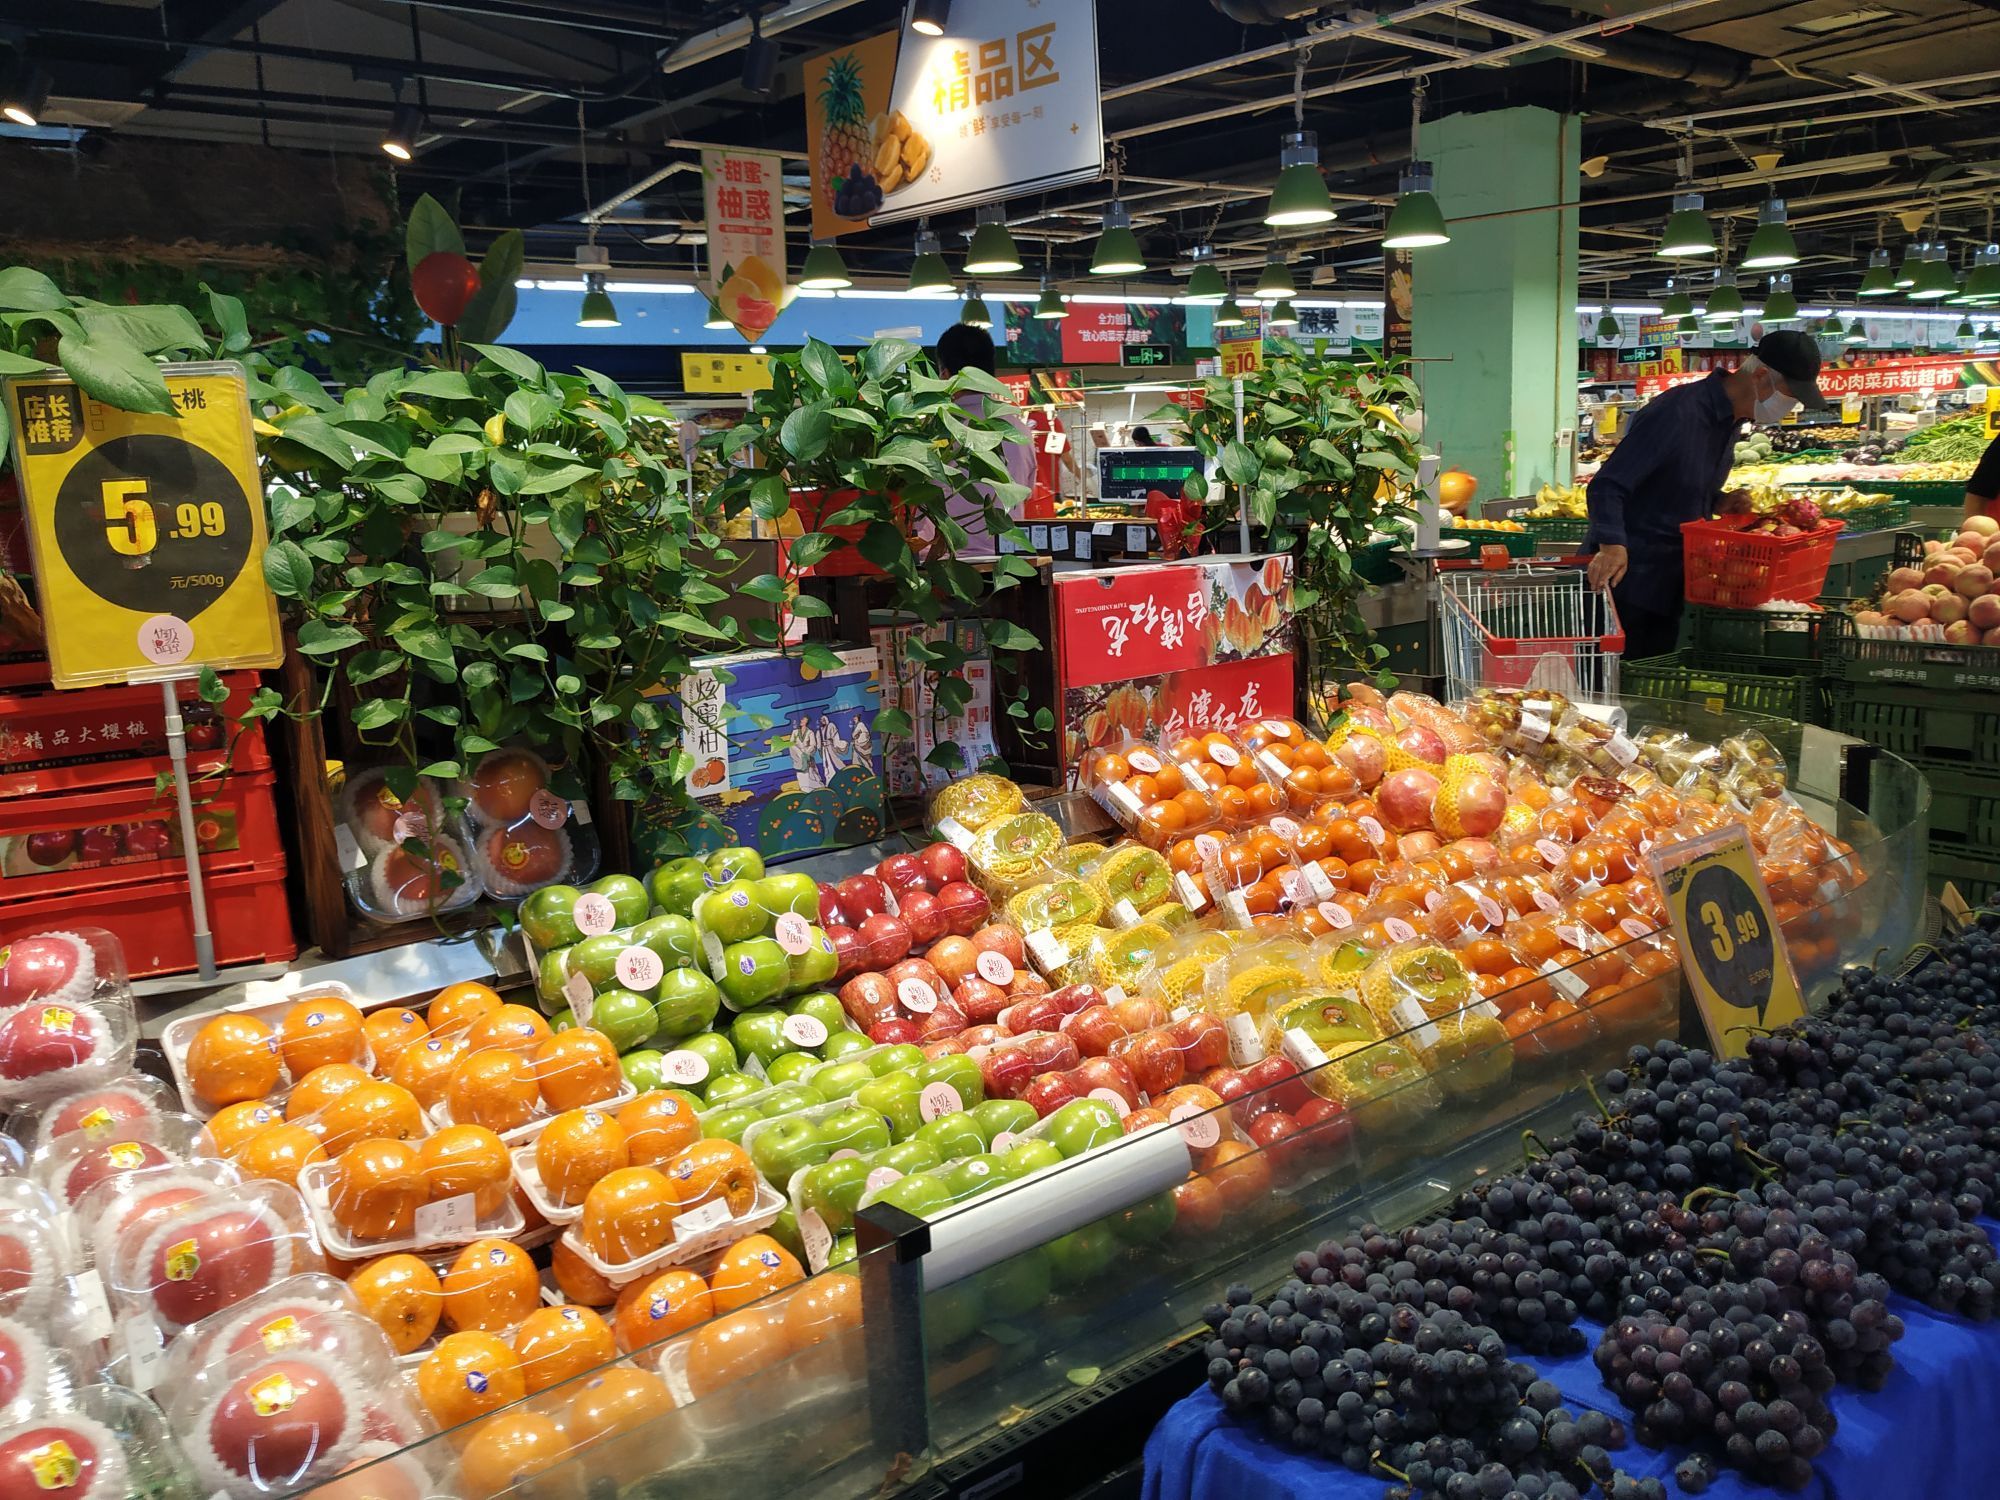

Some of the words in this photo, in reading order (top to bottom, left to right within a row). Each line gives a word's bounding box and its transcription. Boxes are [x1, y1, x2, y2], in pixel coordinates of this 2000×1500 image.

[932, 22, 1060, 115] 精品区
[717, 186, 772, 220] 柚惑
[24, 395, 70, 419] 店长
[27, 419, 73, 443] 推荐
[101, 480, 157, 555] 5
[170, 502, 226, 538] .99
[169, 574, 224, 590] 元/500g
[1101, 590, 1208, 657] 台湾红龙
[1701, 901, 1735, 962] 3
[1736, 910, 1760, 945] .99
